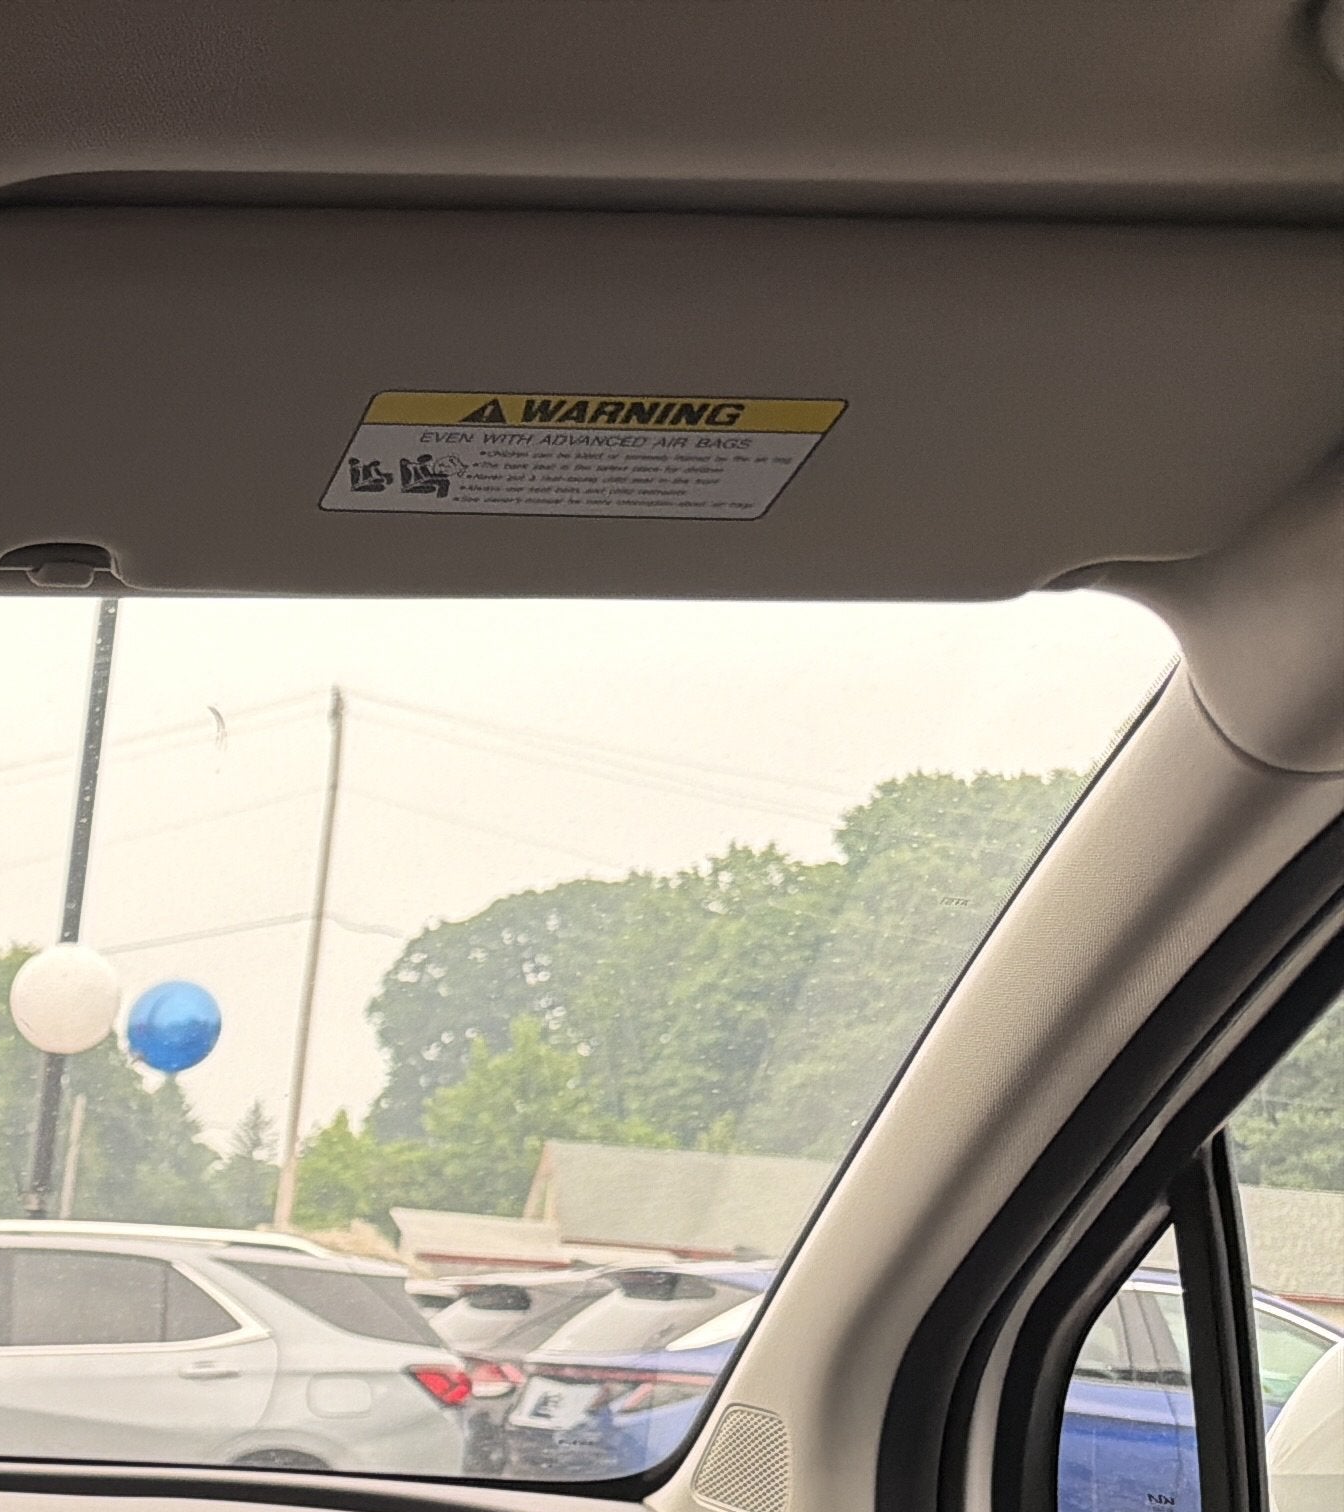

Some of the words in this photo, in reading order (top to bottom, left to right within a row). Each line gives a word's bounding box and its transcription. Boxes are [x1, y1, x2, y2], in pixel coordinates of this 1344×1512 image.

[520, 399, 746, 427] WARNING
[419, 431, 472, 444] EVEN
[481, 432, 533, 445] WITH
[539, 433, 648, 448] ADVANCED
[651, 436, 688, 449] AIR
[695, 436, 751, 450] BAGS
